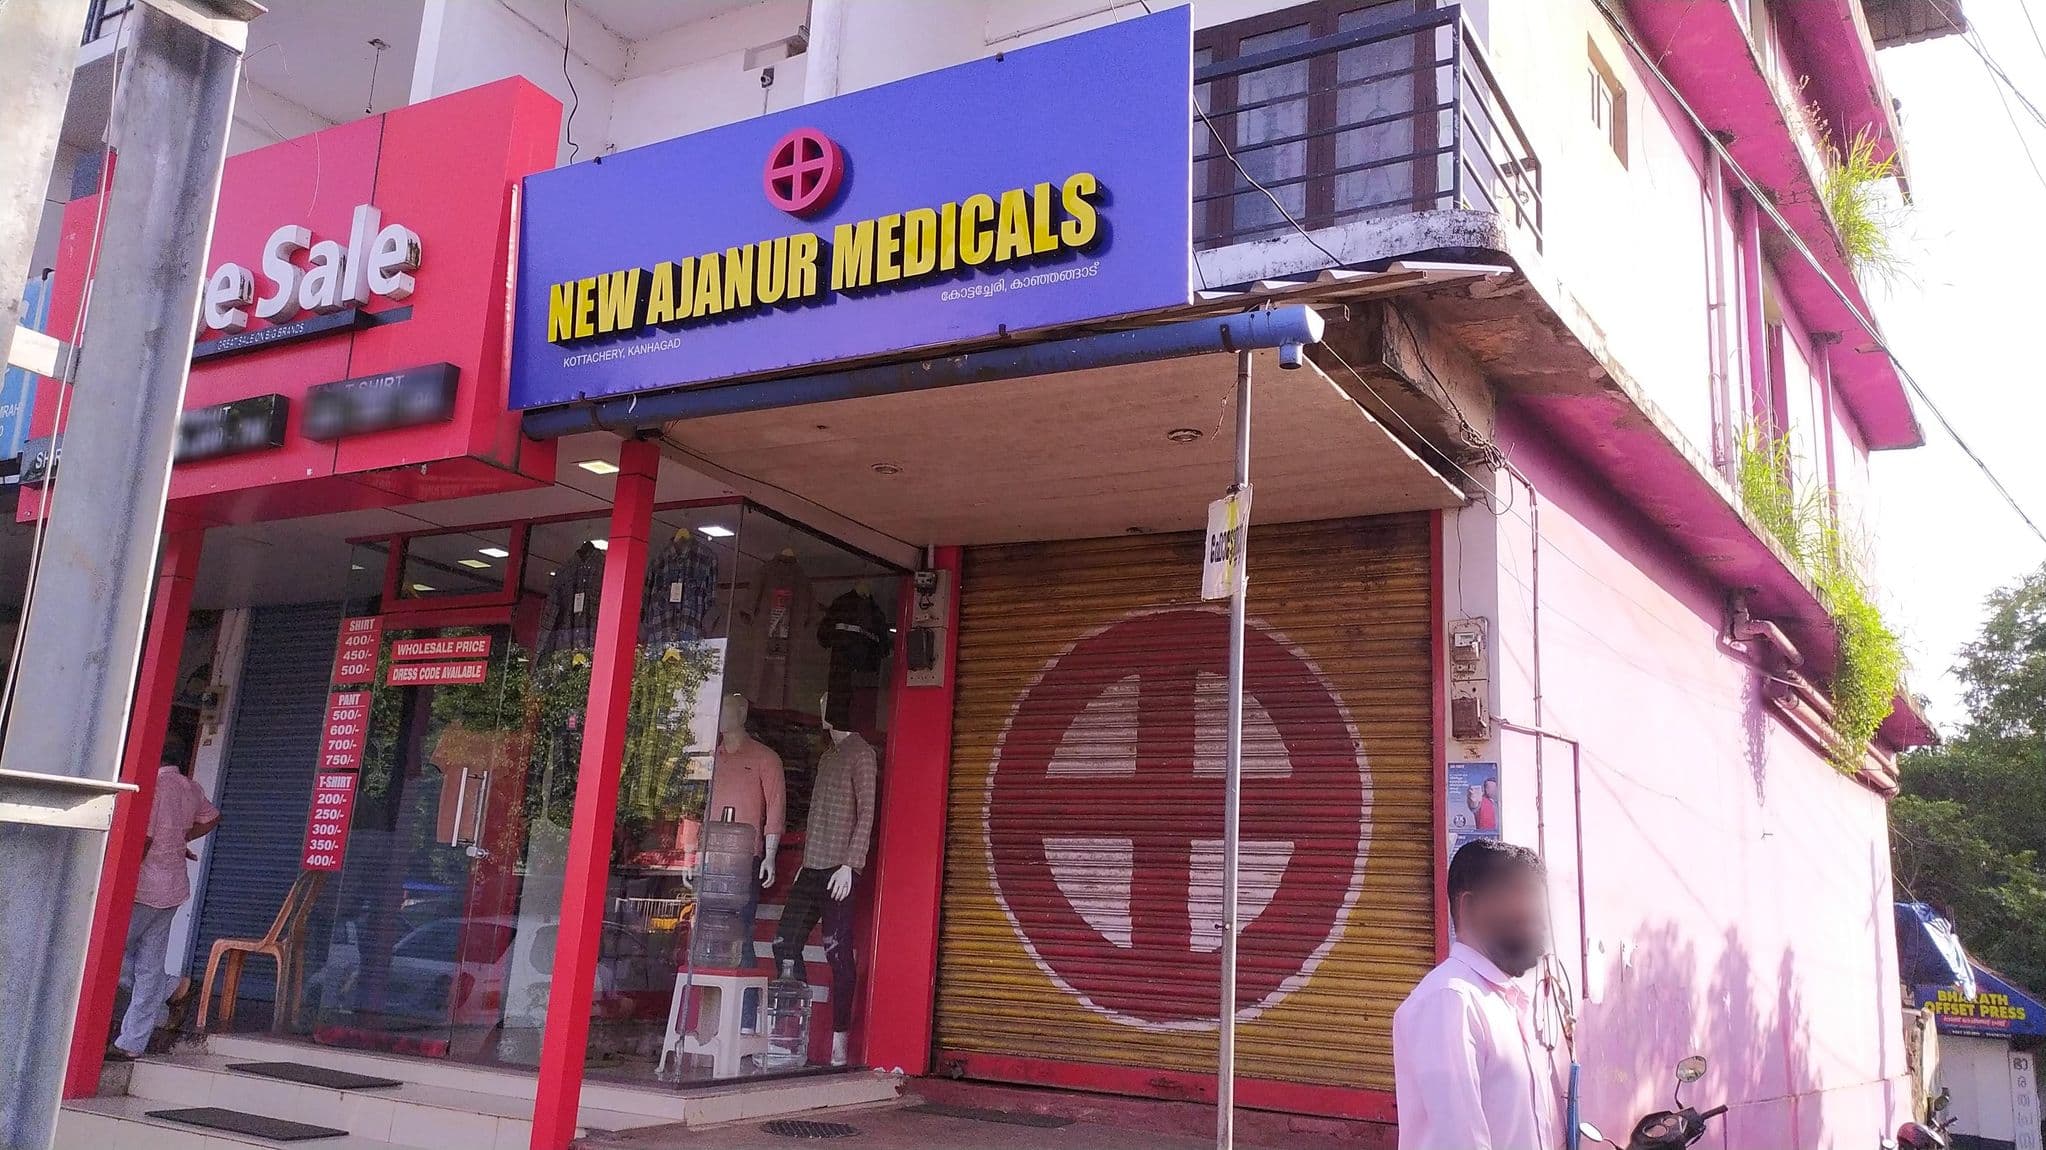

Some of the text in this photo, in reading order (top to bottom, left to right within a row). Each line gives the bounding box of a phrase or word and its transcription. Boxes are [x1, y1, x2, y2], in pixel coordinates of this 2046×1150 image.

[548, 172, 1098, 342] NEW AJANUR MEDICALS
[200, 203, 420, 332] e Sale
[238, 334, 254, 347] SALE
[277, 323, 304, 338] BRANDS
[563, 338, 681, 368] KOTTACHERY, KANHAGAD
[349, 618, 375, 631] SHIRT
[345, 635, 374, 646] 400/-
[398, 640, 485, 655] WHOLESALE PRICE
[343, 650, 372, 660] 450/-
[341, 664, 370, 676] 500/-
[393, 666, 482, 681] DRESS CODE AVAILABLE
[338, 694, 361, 706] PANT
[332, 710, 362, 721] 500/-
[330, 725, 359, 735] 600/-
[328, 740, 357, 750] 700/-
[326, 755, 354, 765] 750/-
[319, 776, 352, 788] T-SHIRT
[317, 793, 347, 805] 200/-
[315, 809, 344, 820] 250/-
[312, 824, 341, 835] 300/-
[310, 839, 338, 850] 350/-
[306, 855, 336, 866] 400/-
[1924, 1001, 2026, 1021] OFFSET PRESS
